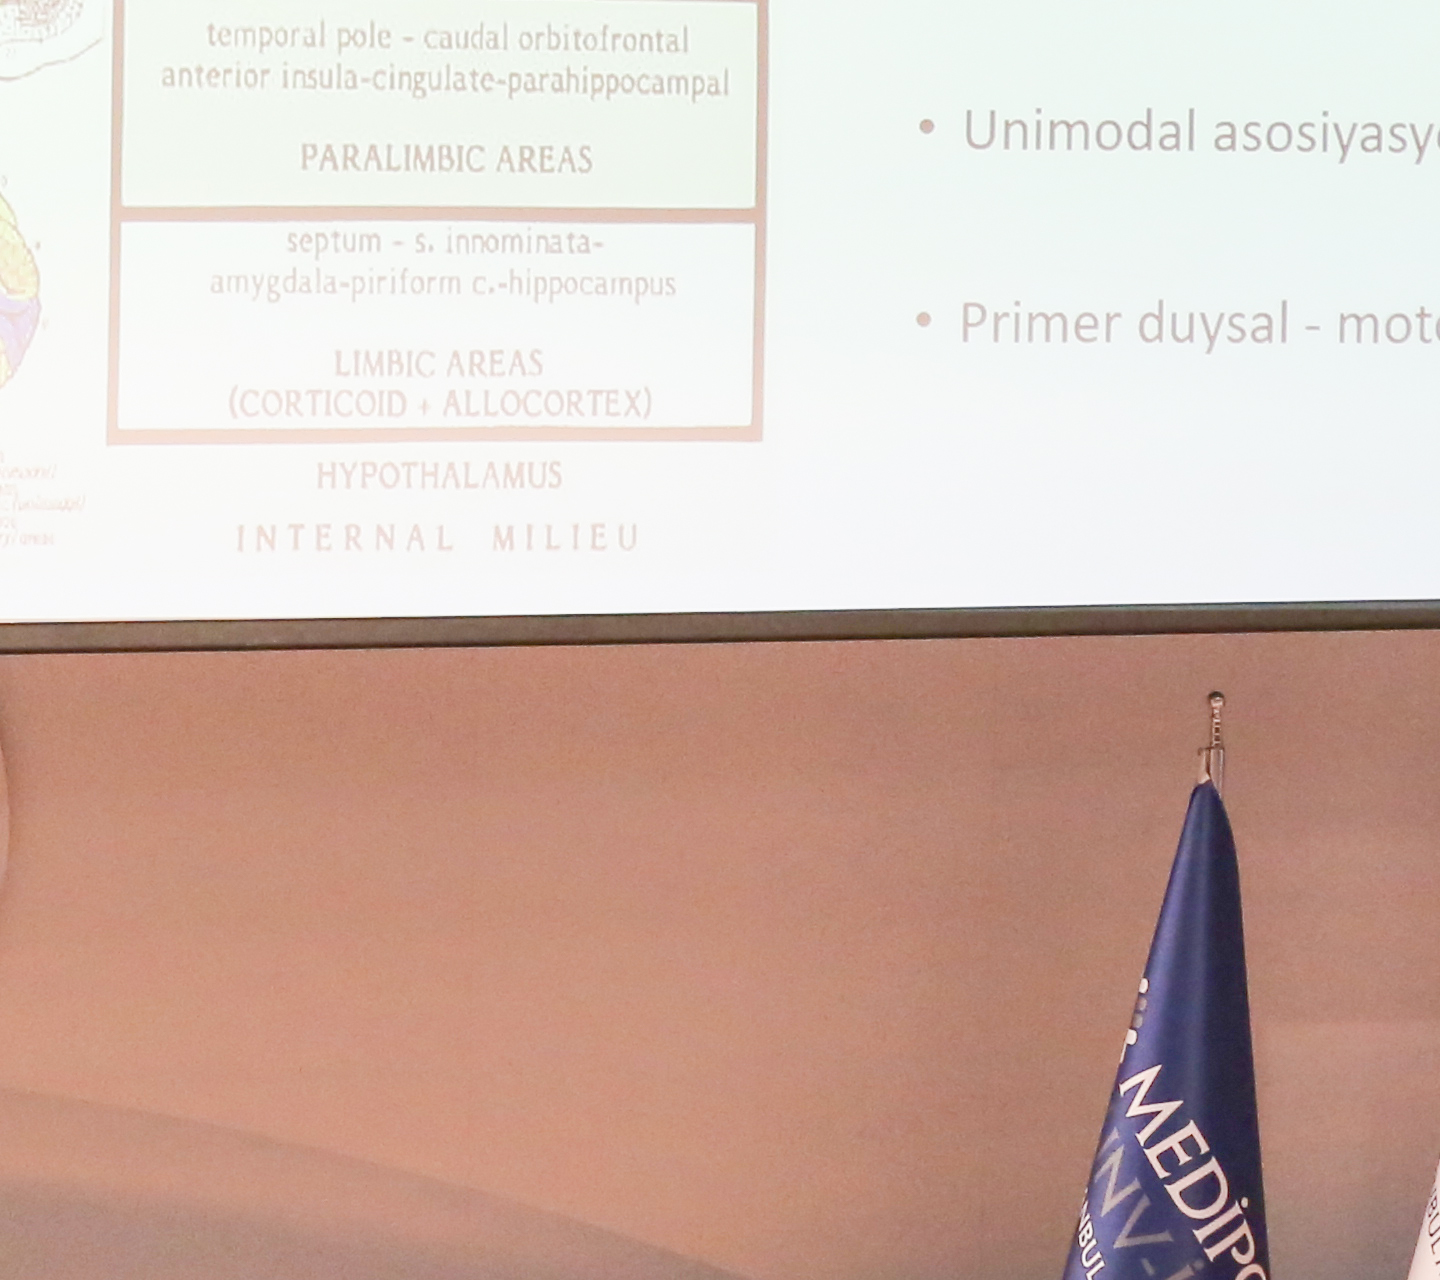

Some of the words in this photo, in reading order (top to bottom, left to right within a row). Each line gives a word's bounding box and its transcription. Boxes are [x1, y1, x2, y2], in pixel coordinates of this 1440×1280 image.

[207, 21, 327, 56] temporal
[336, 22, 392, 55] pole
[424, 23, 510, 54] caudal
[518, 23, 690, 55] orbitofrontal
[162, 61, 271, 91] anterior
[964, 107, 1196, 152] Unimodal
[300, 142, 485, 174] PARALIMBIC
[496, 144, 594, 175] AREAS
[287, 229, 383, 261] septum
[446, 228, 605, 255] innominata-
[210, 267, 462, 304] amygdala-piriform
[962, 299, 1123, 344] Primer
[1138, 300, 1288, 354] duysal
[334, 348, 436, 379] LIMBIC
[446, 349, 544, 379] AREAS
[229, 386, 408, 420] (CORTICOID
[443, 386, 652, 420] ALLOCORTEX)
[316, 461, 563, 492] HYPOTHALAMUS
[237, 523, 454, 553] INTERNAL
[493, 522, 638, 553] MILIEU
